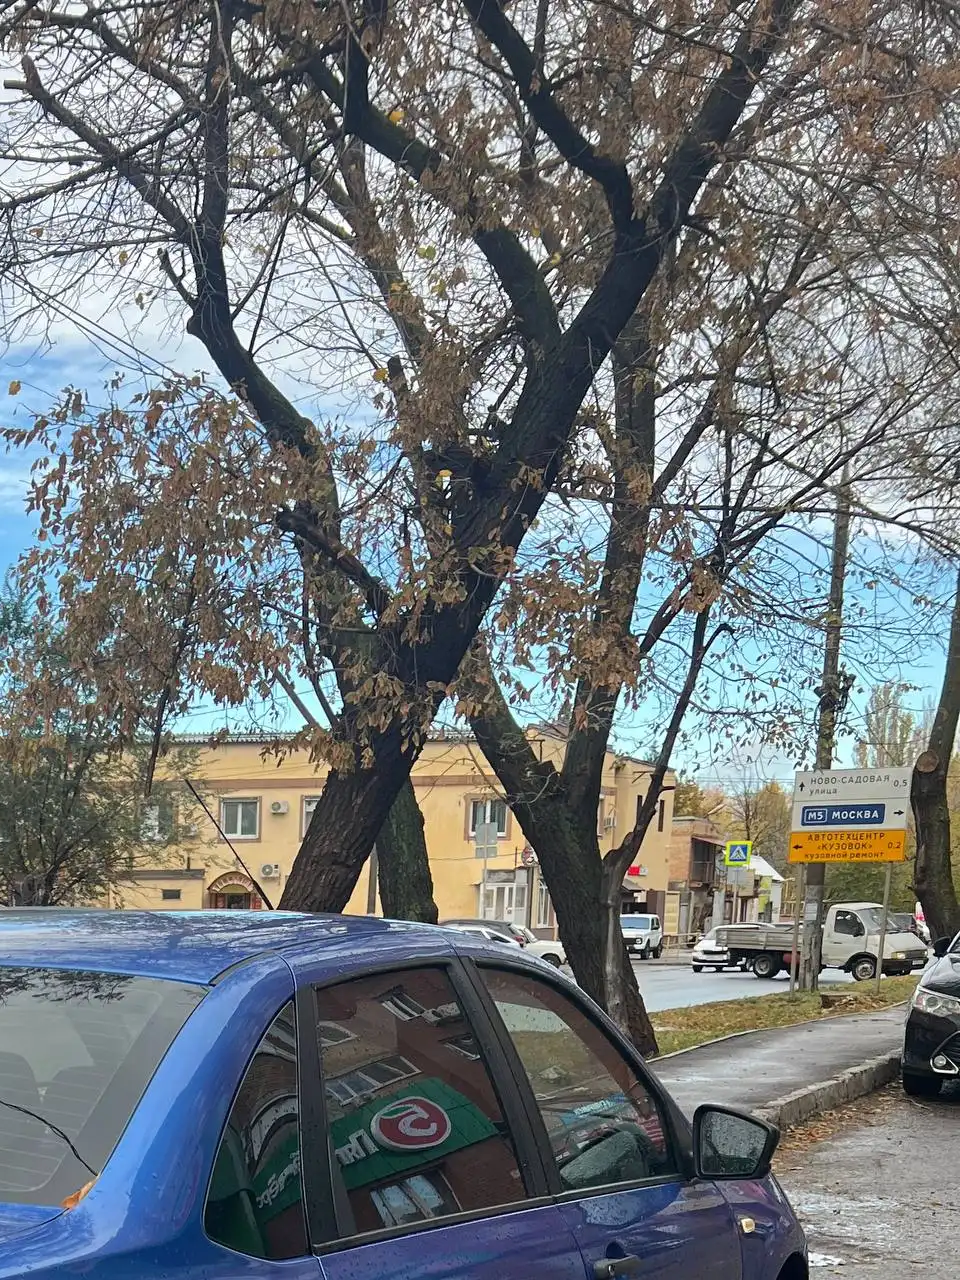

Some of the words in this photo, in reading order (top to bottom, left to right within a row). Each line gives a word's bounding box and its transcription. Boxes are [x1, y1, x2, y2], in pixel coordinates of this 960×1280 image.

[810, 775, 890, 785] НОВО-САДОВАЯ
[809, 788, 838, 796] улица
[832, 810, 879, 820] МОСКВА
[807, 833, 885, 841] АВТОТЕХЦЕНТР
[849, 852, 884, 860] ремонт
